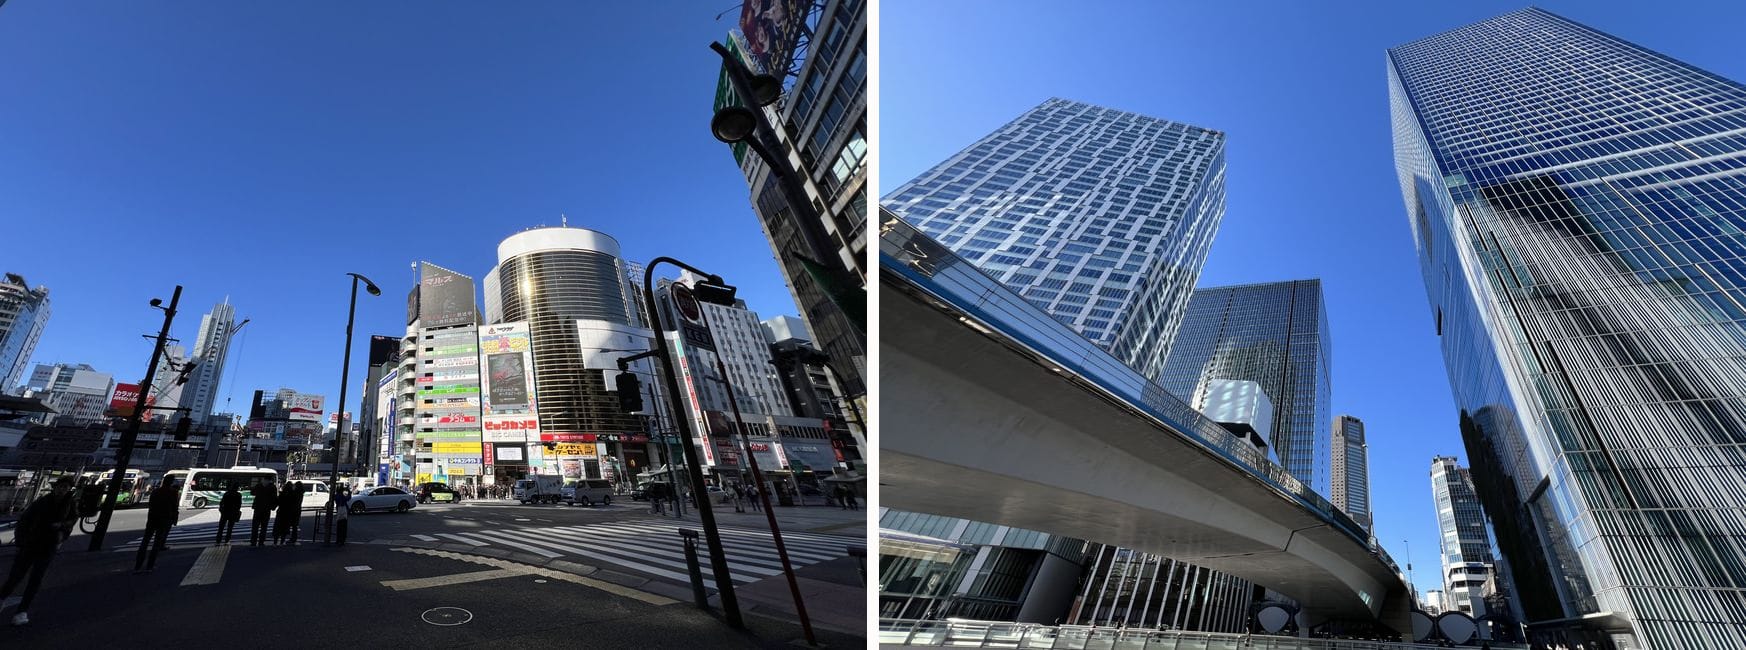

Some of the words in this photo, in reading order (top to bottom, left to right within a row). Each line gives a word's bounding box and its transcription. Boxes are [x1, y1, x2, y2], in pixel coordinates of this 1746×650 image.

[484, 420, 537, 431] ビックカメラ
